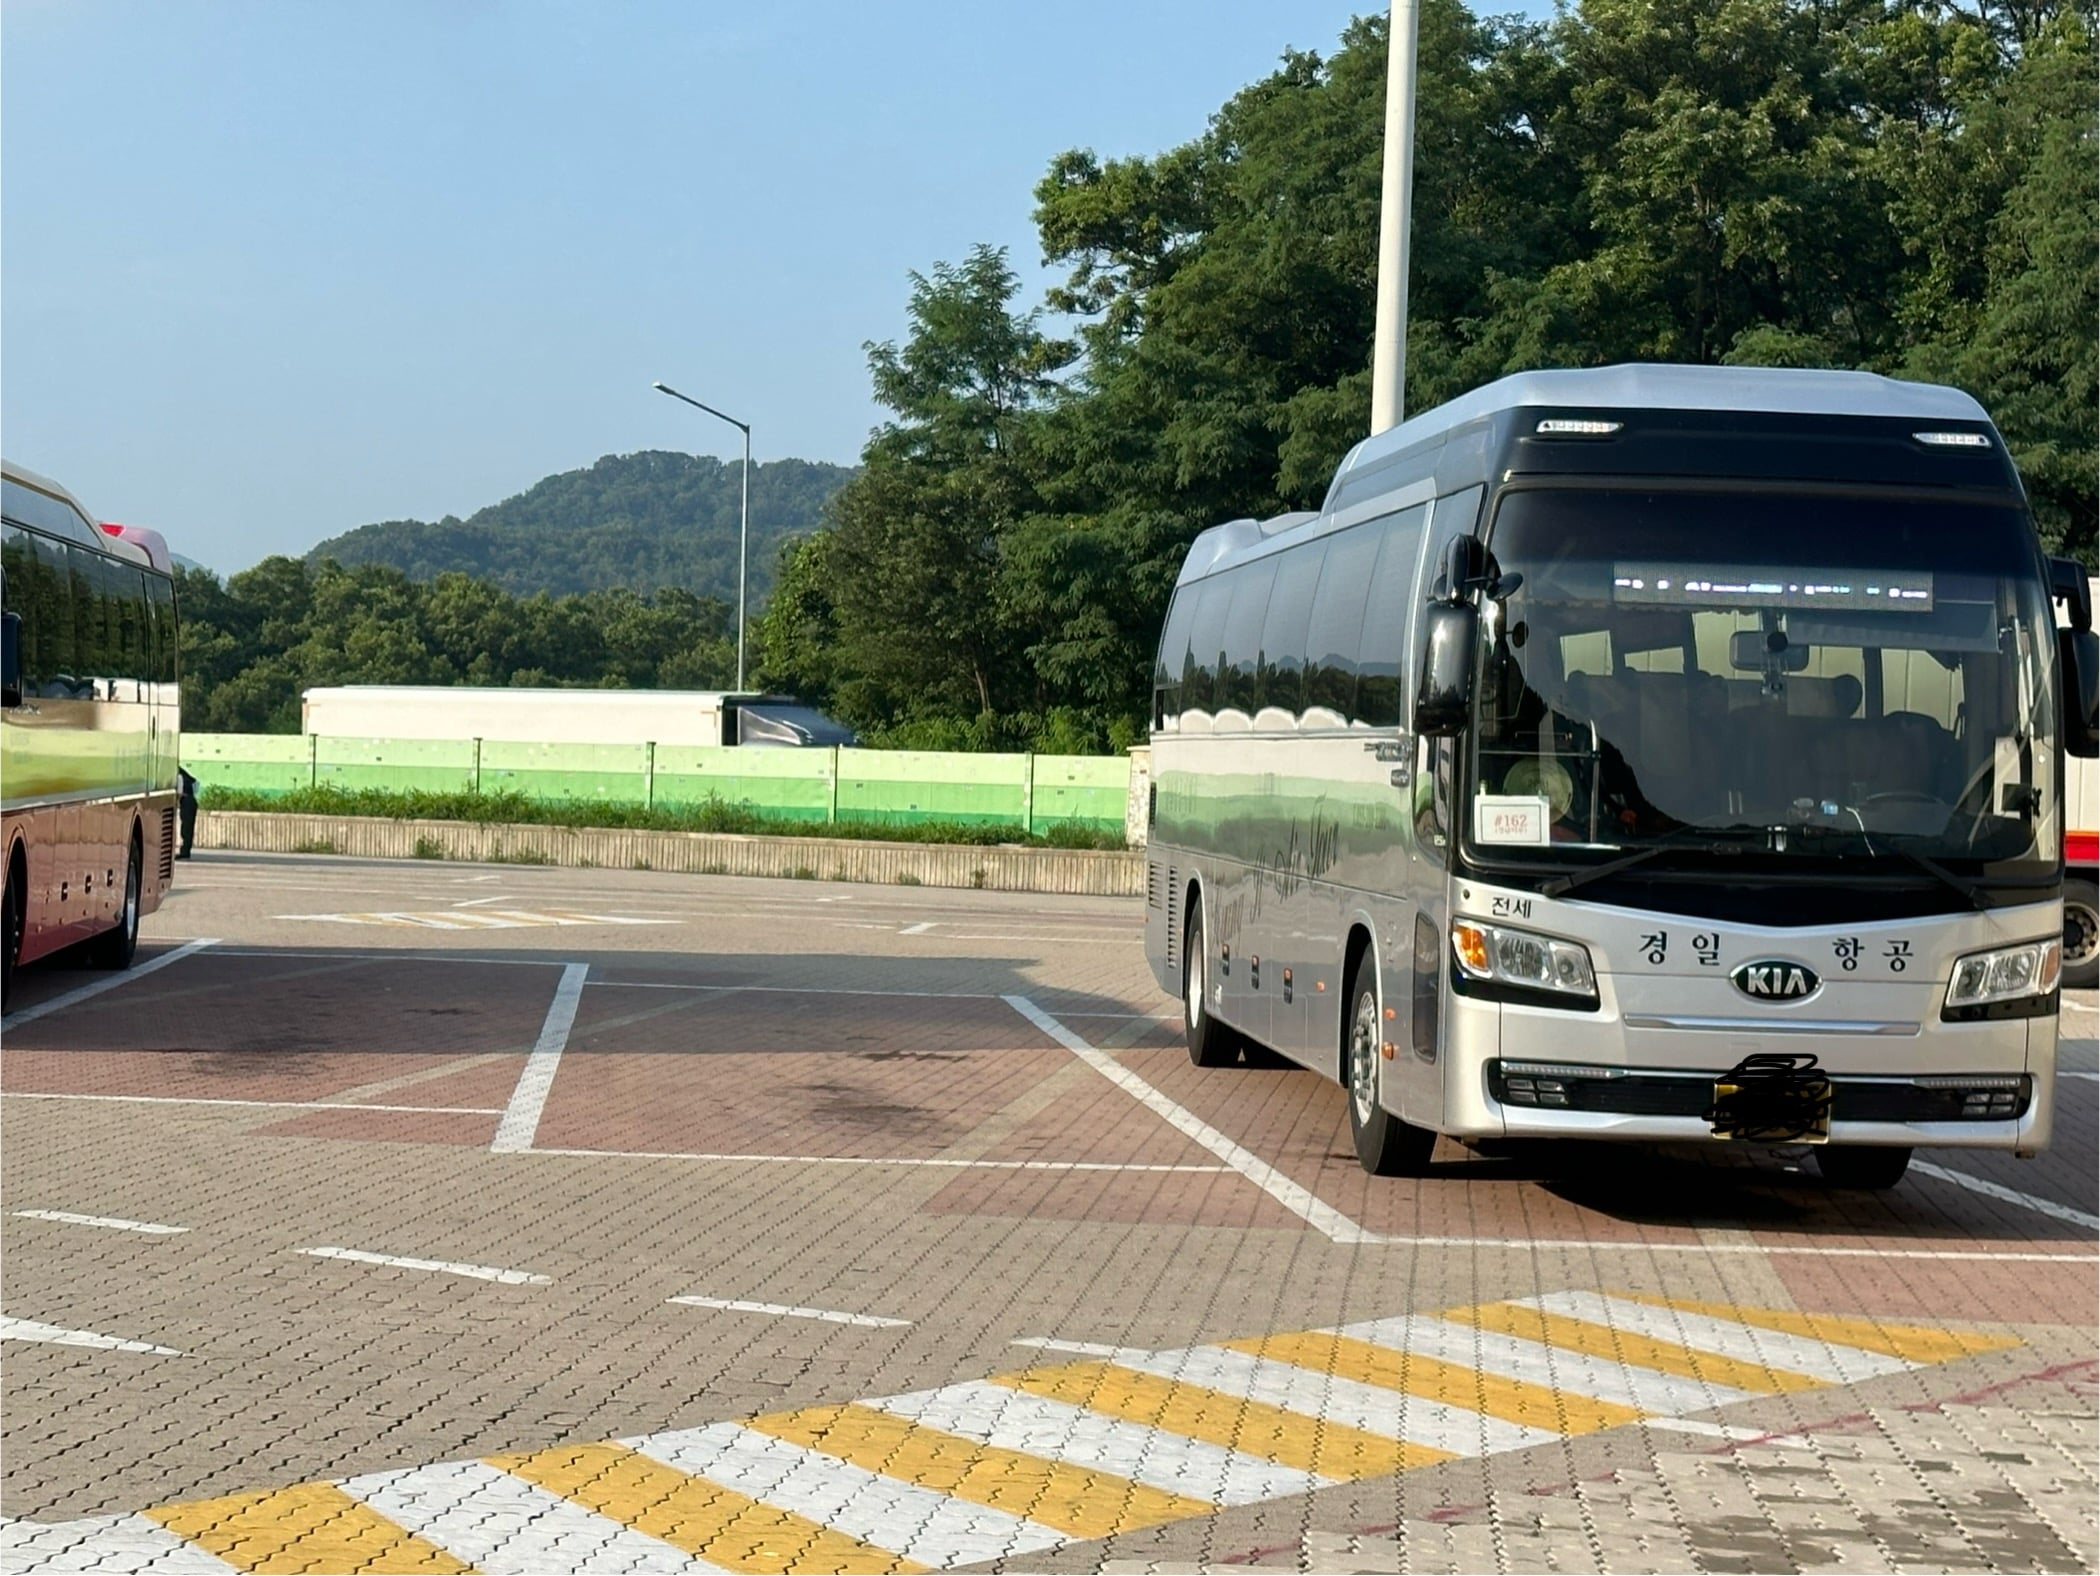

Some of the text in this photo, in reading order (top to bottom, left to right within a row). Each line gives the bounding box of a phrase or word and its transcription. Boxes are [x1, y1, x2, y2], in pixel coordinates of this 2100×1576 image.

[1494, 814, 1528, 828] #162
[1492, 896, 1532, 920] 전세
[1746, 967, 1808, 995] KIA
